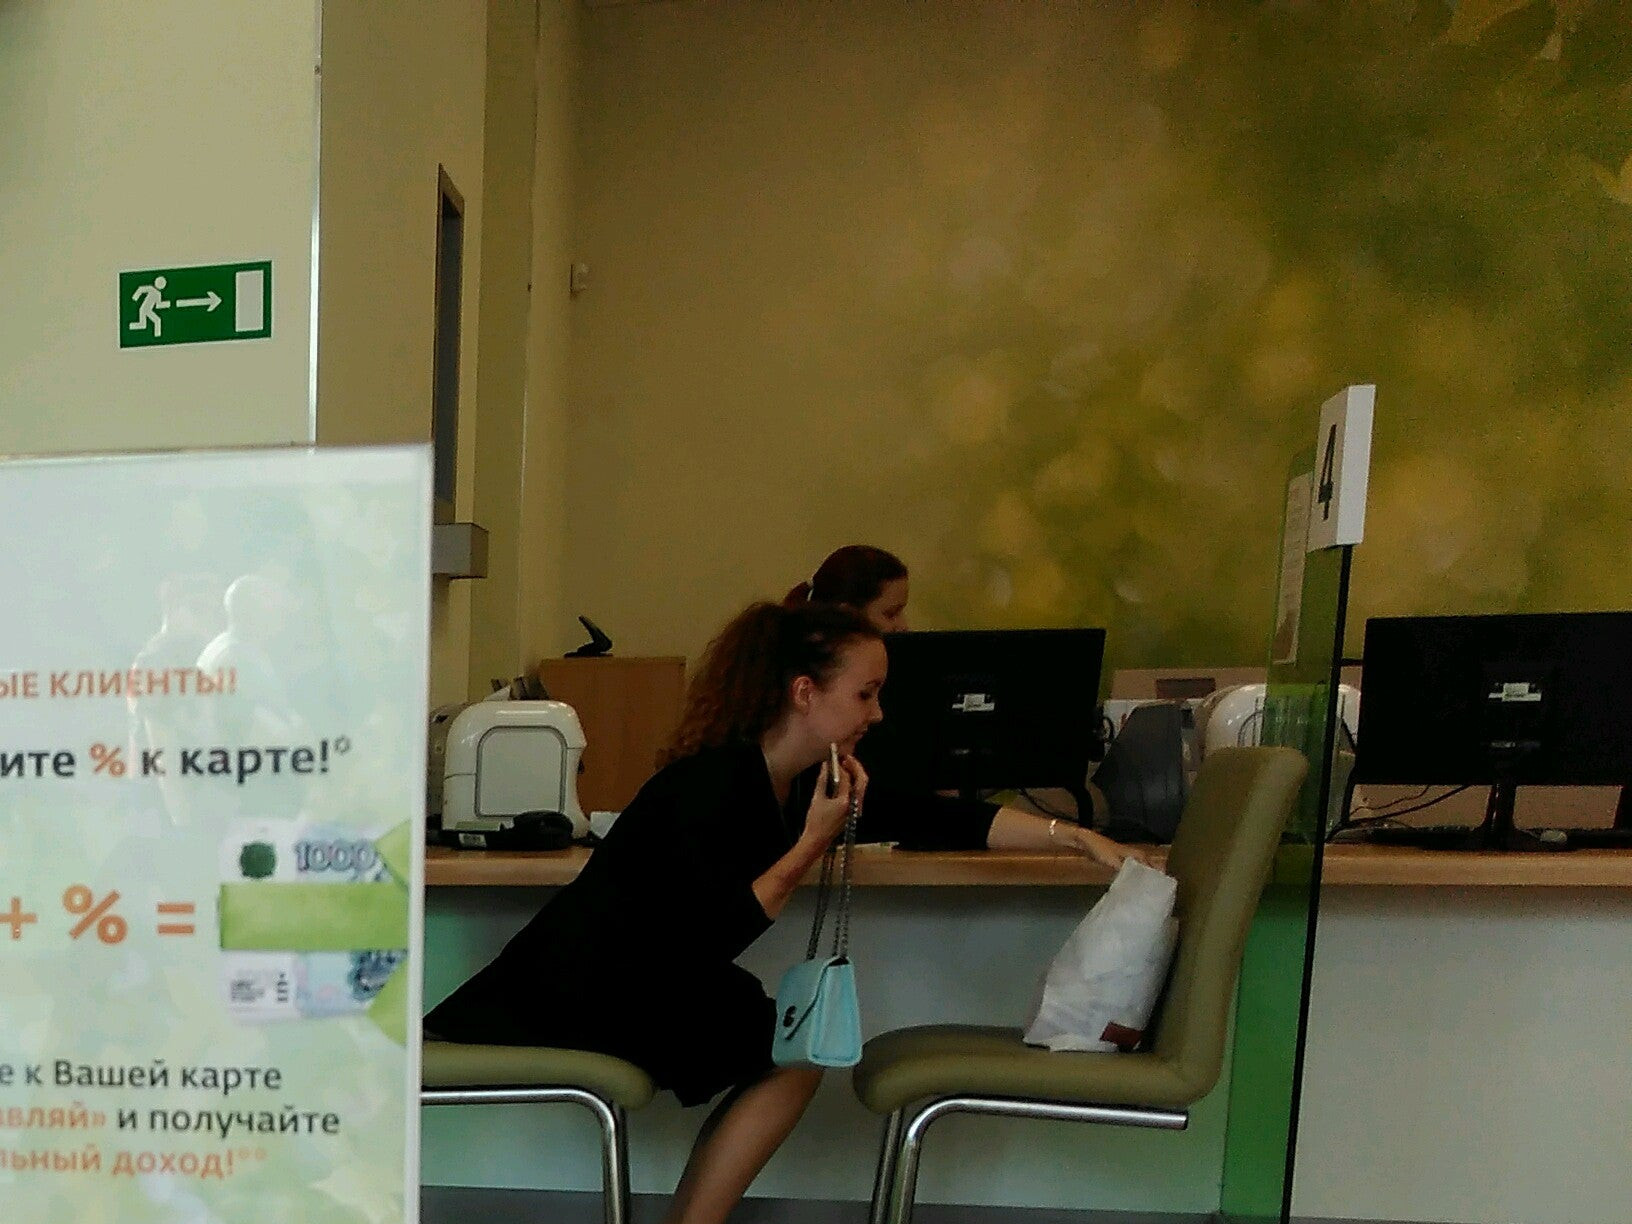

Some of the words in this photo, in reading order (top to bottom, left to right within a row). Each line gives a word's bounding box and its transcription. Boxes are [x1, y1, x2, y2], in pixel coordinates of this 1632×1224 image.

[1317, 423, 1337, 521] 4
[49, 666, 237, 699] КЛИЕНТЫ!
[142, 748, 166, 777] к
[25, 1064, 43, 1086] к
[54, 1058, 169, 1089] Вашей
[181, 1065, 283, 1096] карте
[118, 1108, 137, 1130] и
[149, 1104, 341, 1139] получайте
